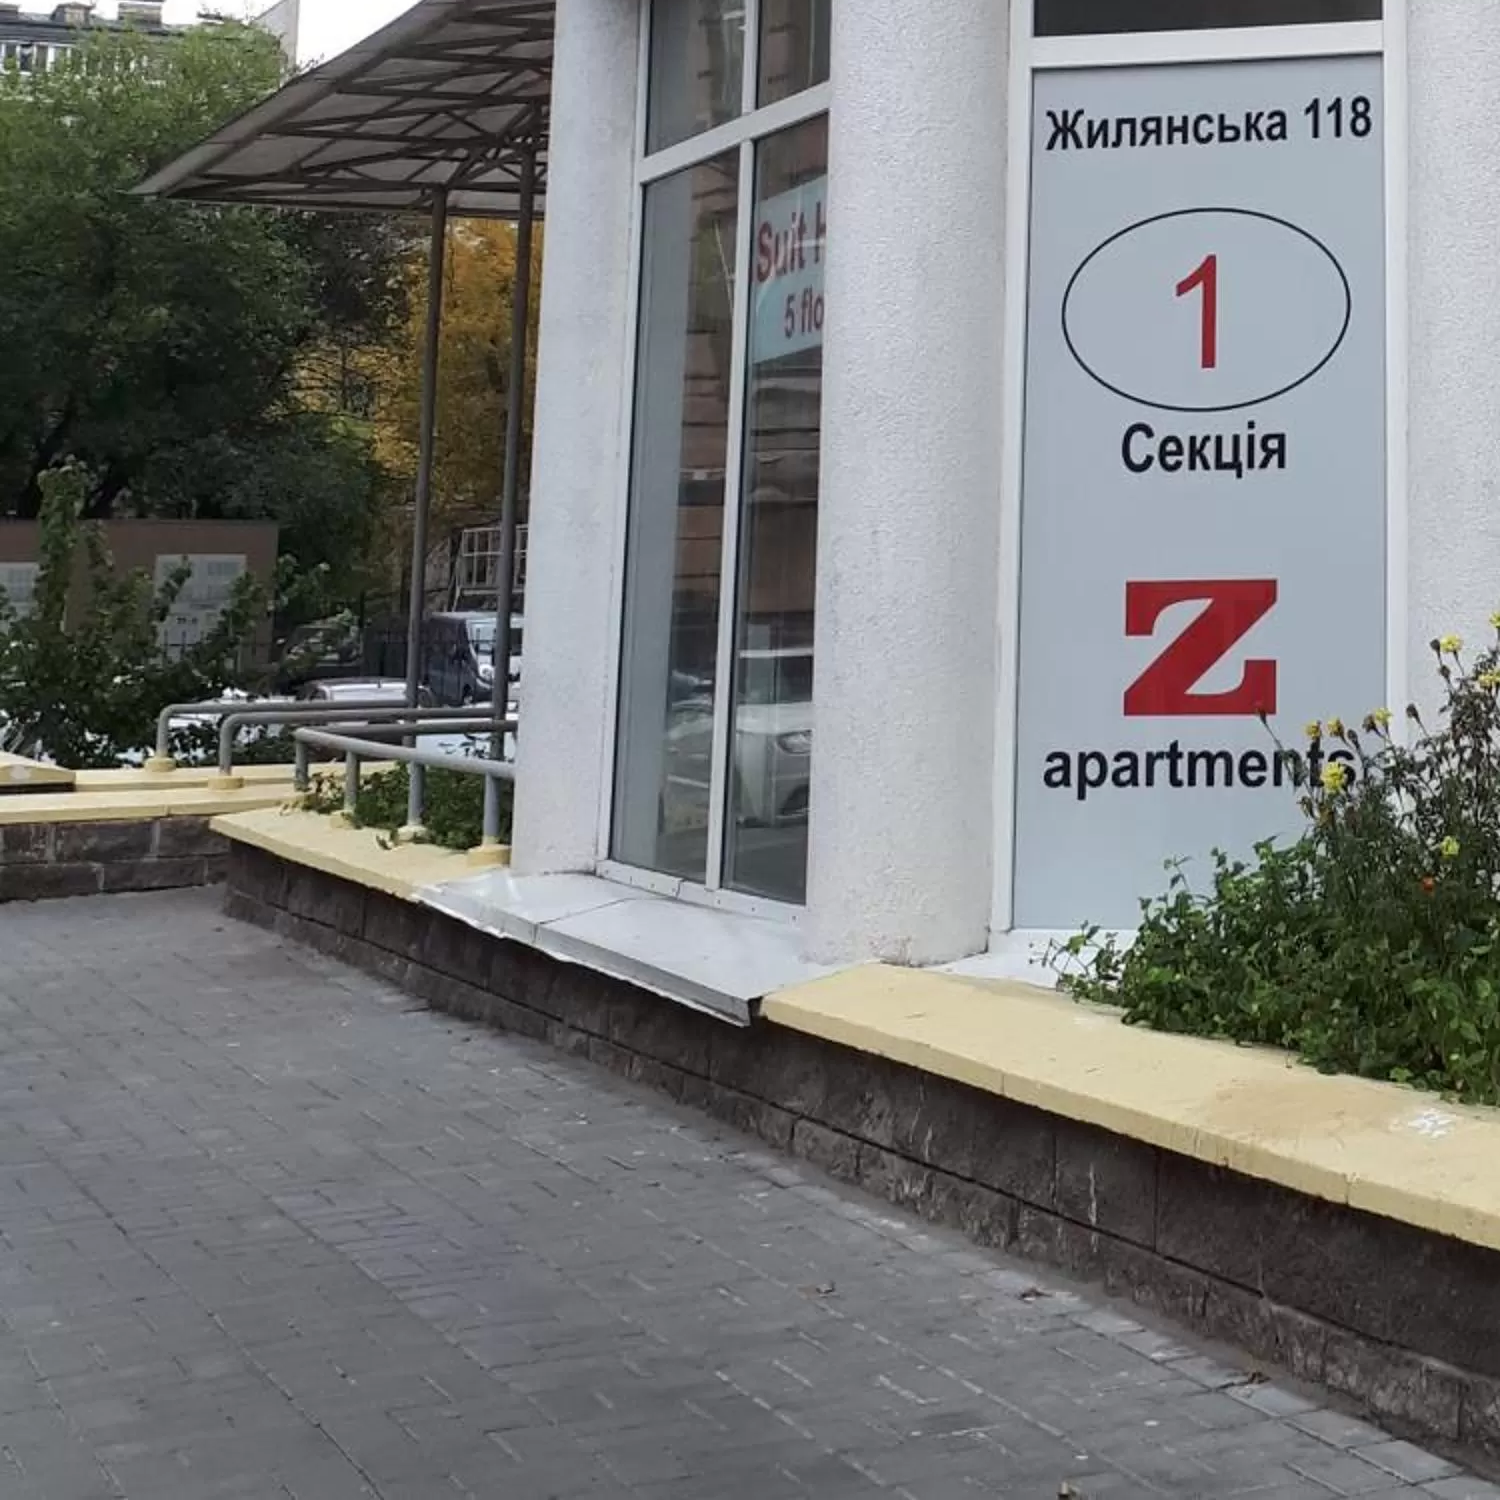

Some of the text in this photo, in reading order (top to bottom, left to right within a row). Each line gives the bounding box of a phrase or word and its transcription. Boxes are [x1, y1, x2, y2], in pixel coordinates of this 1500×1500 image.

[1045, 95, 1372, 151] Жилянська 118
[757, 211, 806, 283] Suit
[784, 293, 796, 339] 5
[1175, 254, 1217, 368] 1
[1121, 421, 1287, 479] Секція
[1123, 579, 1278, 716] Z
[1043, 740, 1356, 801] apartments
